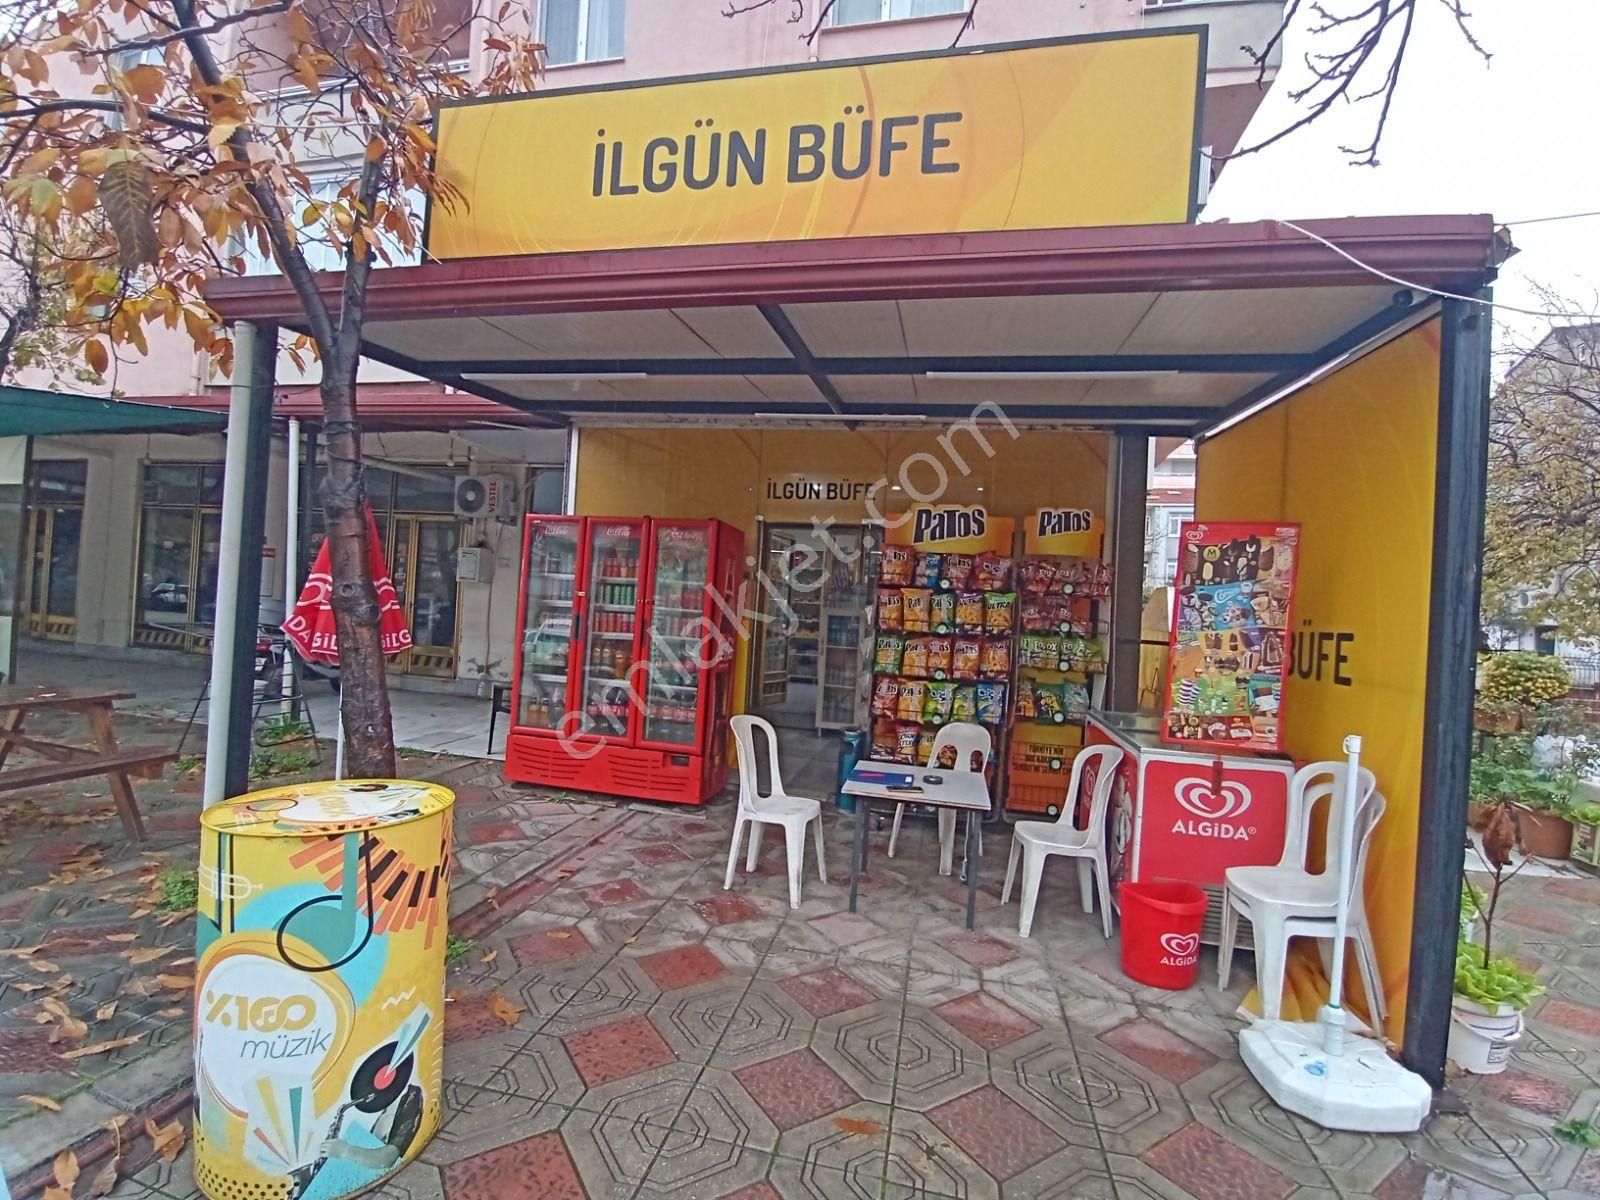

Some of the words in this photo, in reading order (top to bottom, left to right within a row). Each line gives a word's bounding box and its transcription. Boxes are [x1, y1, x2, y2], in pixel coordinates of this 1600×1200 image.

[592, 118, 767, 198] İLGÜN
[786, 104, 963, 184] BÜFE
[487, 480, 497, 513] VESTEL
[766, 477, 822, 500] İLGÜN
[826, 477, 876, 500] BÜFE
[206, 989, 317, 1033] %100
[240, 1027, 333, 1059] müzik
